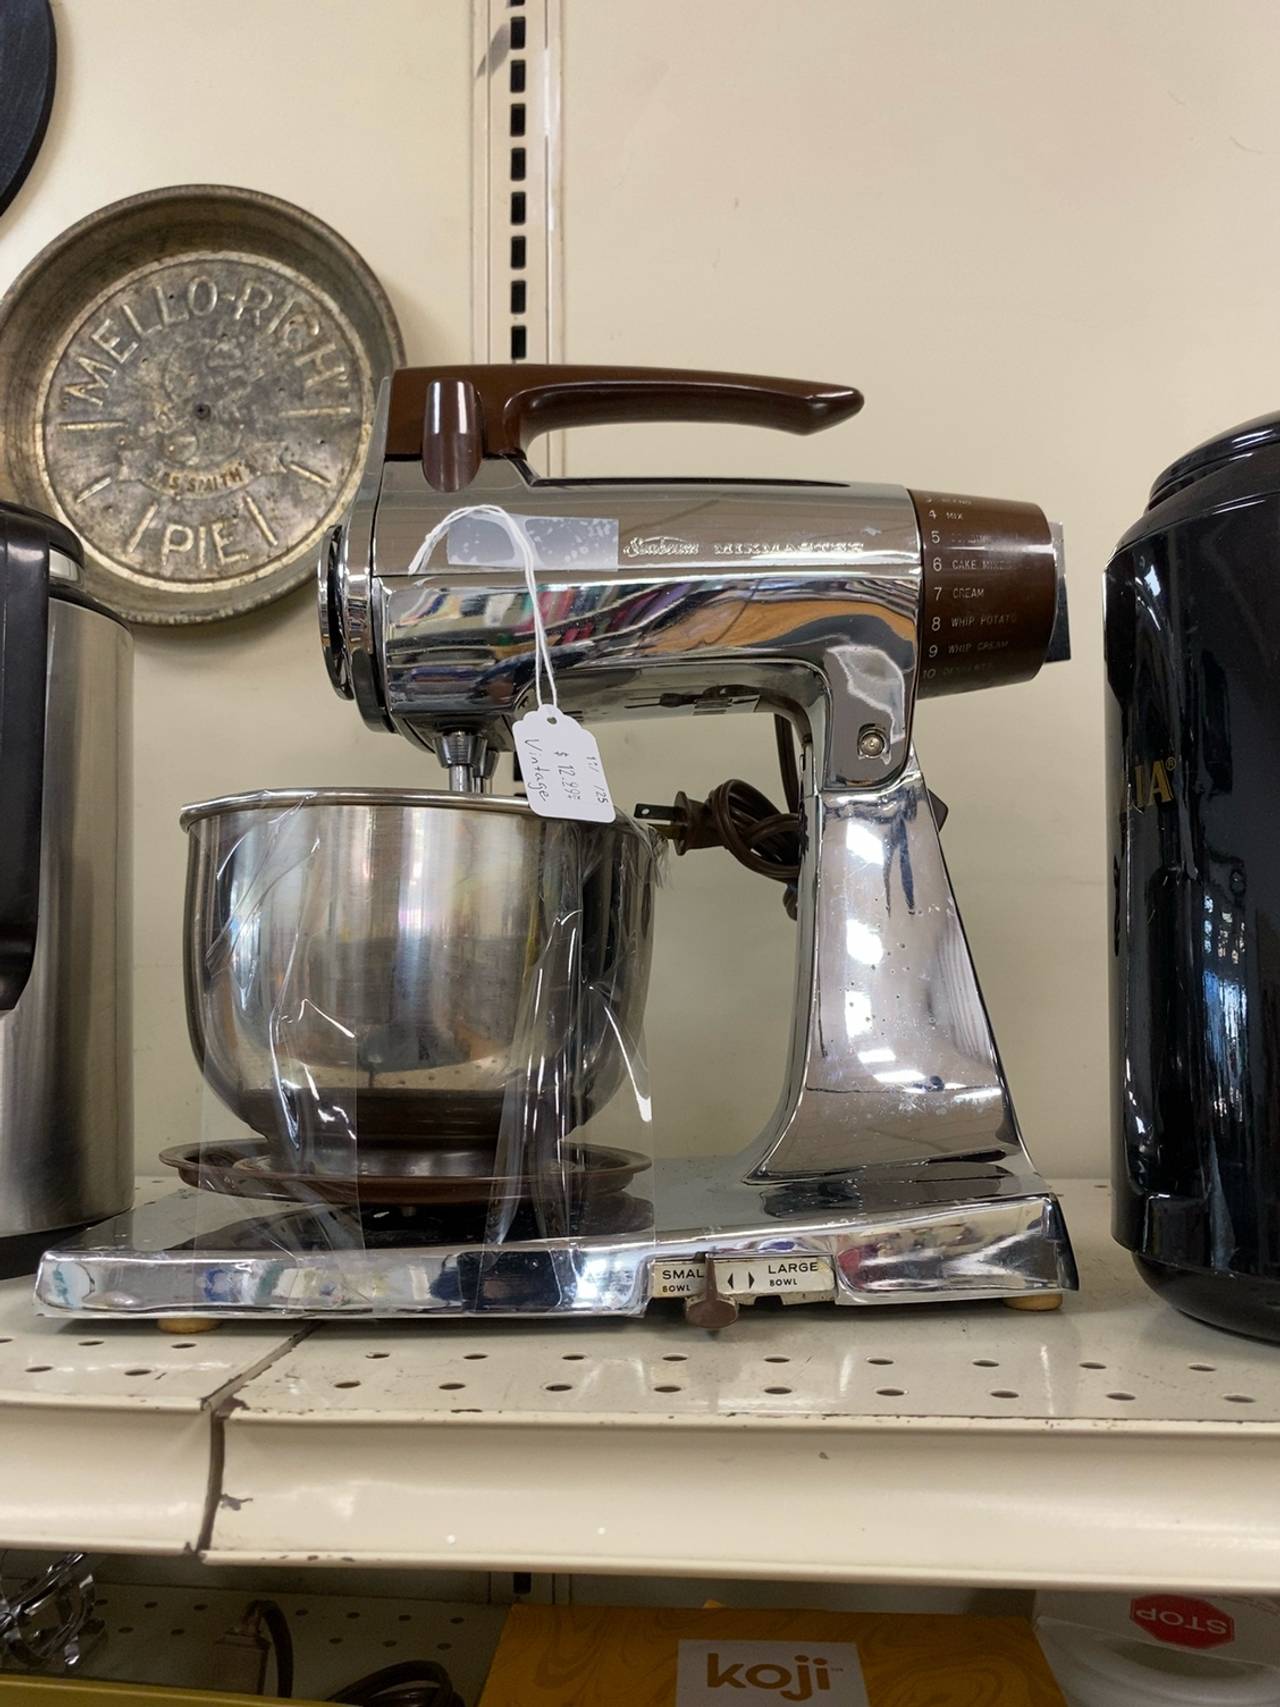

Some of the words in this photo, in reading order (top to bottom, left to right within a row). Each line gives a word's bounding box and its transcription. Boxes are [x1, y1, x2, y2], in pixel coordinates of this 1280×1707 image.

[160, 518, 250, 572] PIE
[930, 530, 942, 545] 5
[932, 556, 943, 572] 6
[952, 559, 977, 571] CAKE
[933, 586, 943, 601] 7
[952, 587, 985, 599] CREAM
[931, 616, 942, 632] 8
[951, 617, 976, 628] WHIP
[928, 644, 939, 658] 9
[947, 644, 972, 654] WHIP
[922, 668, 937, 680] 10
[524, 738, 552, 802] Vintage
[662, 1268, 705, 1281] SMAL
[768, 1262, 819, 1275] LARGE
[662, 1284, 691, 1294] BOWL
[769, 1278, 799, 1288] BOWL
[1135, 1607, 1228, 1635] STOP
[707, 1652, 831, 1702] koji
